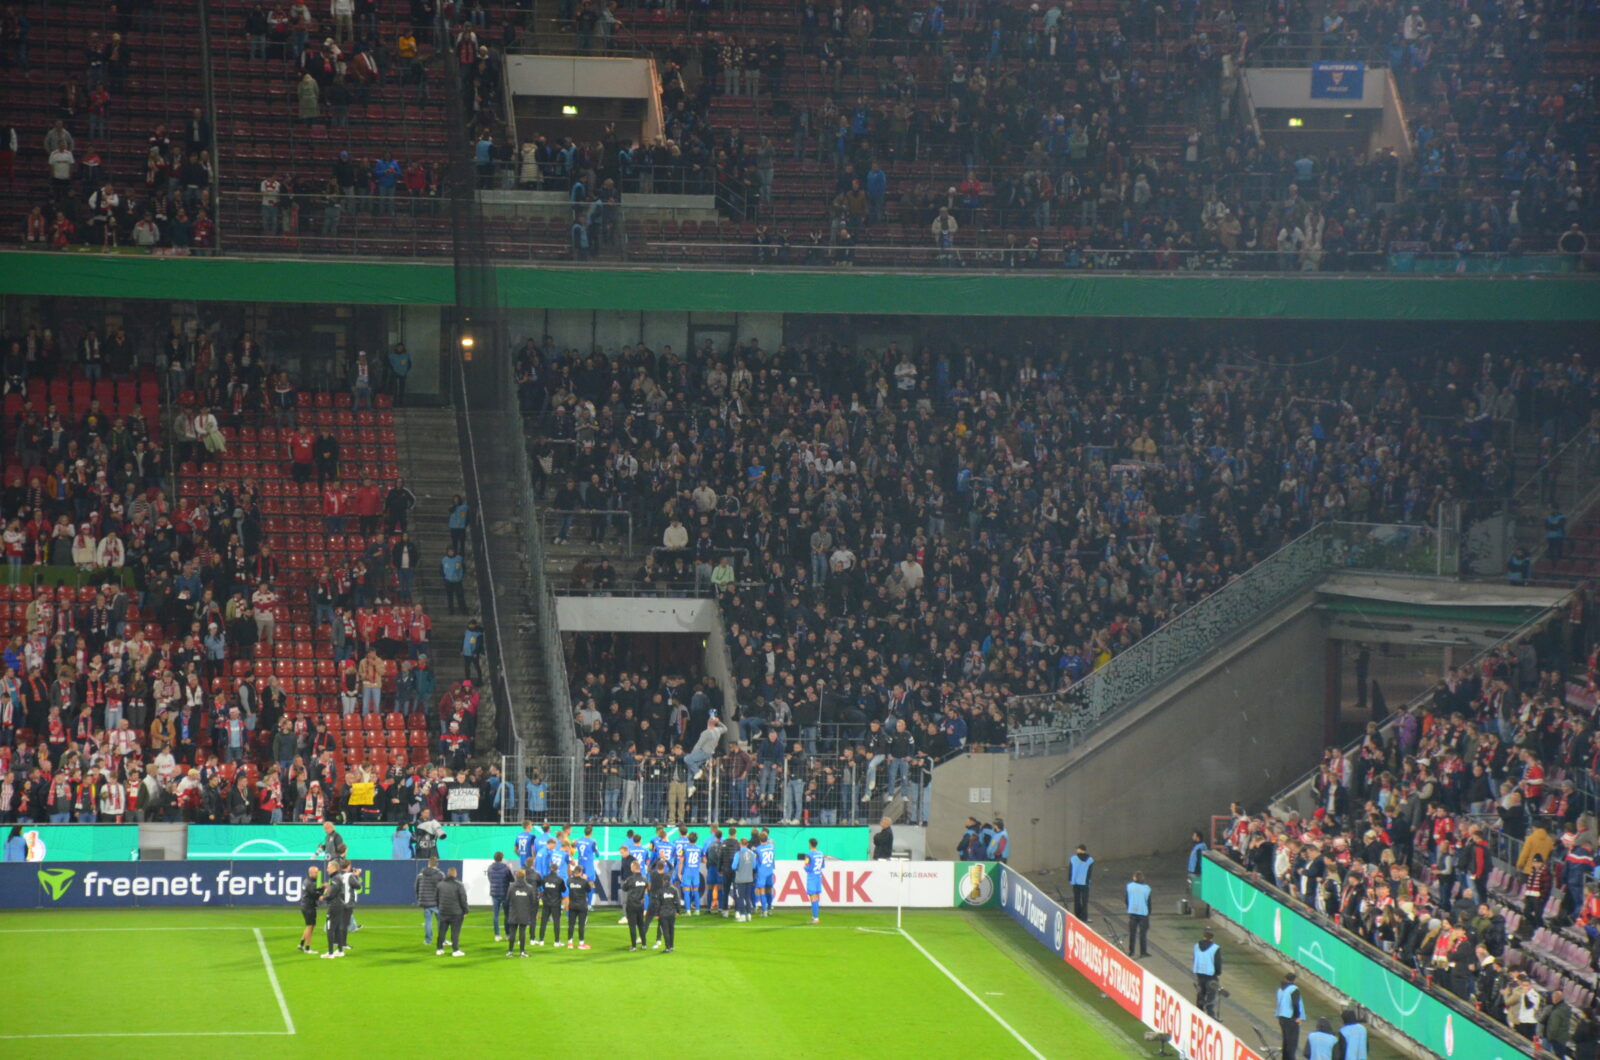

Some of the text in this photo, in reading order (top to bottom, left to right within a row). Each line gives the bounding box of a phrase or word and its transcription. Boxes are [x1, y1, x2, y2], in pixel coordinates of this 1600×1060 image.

[688, 851, 699, 864] 18
[762, 851, 774, 864] 20
[83, 871, 211, 903] freenet,
[215, 870, 303, 902] fertig
[771, 870, 874, 903] ANK
[1074, 930, 1141, 1006] STRAUSS STRAUSS
[1154, 984, 1182, 1045] ERGO
[1190, 1012, 1223, 1060] ERGO
